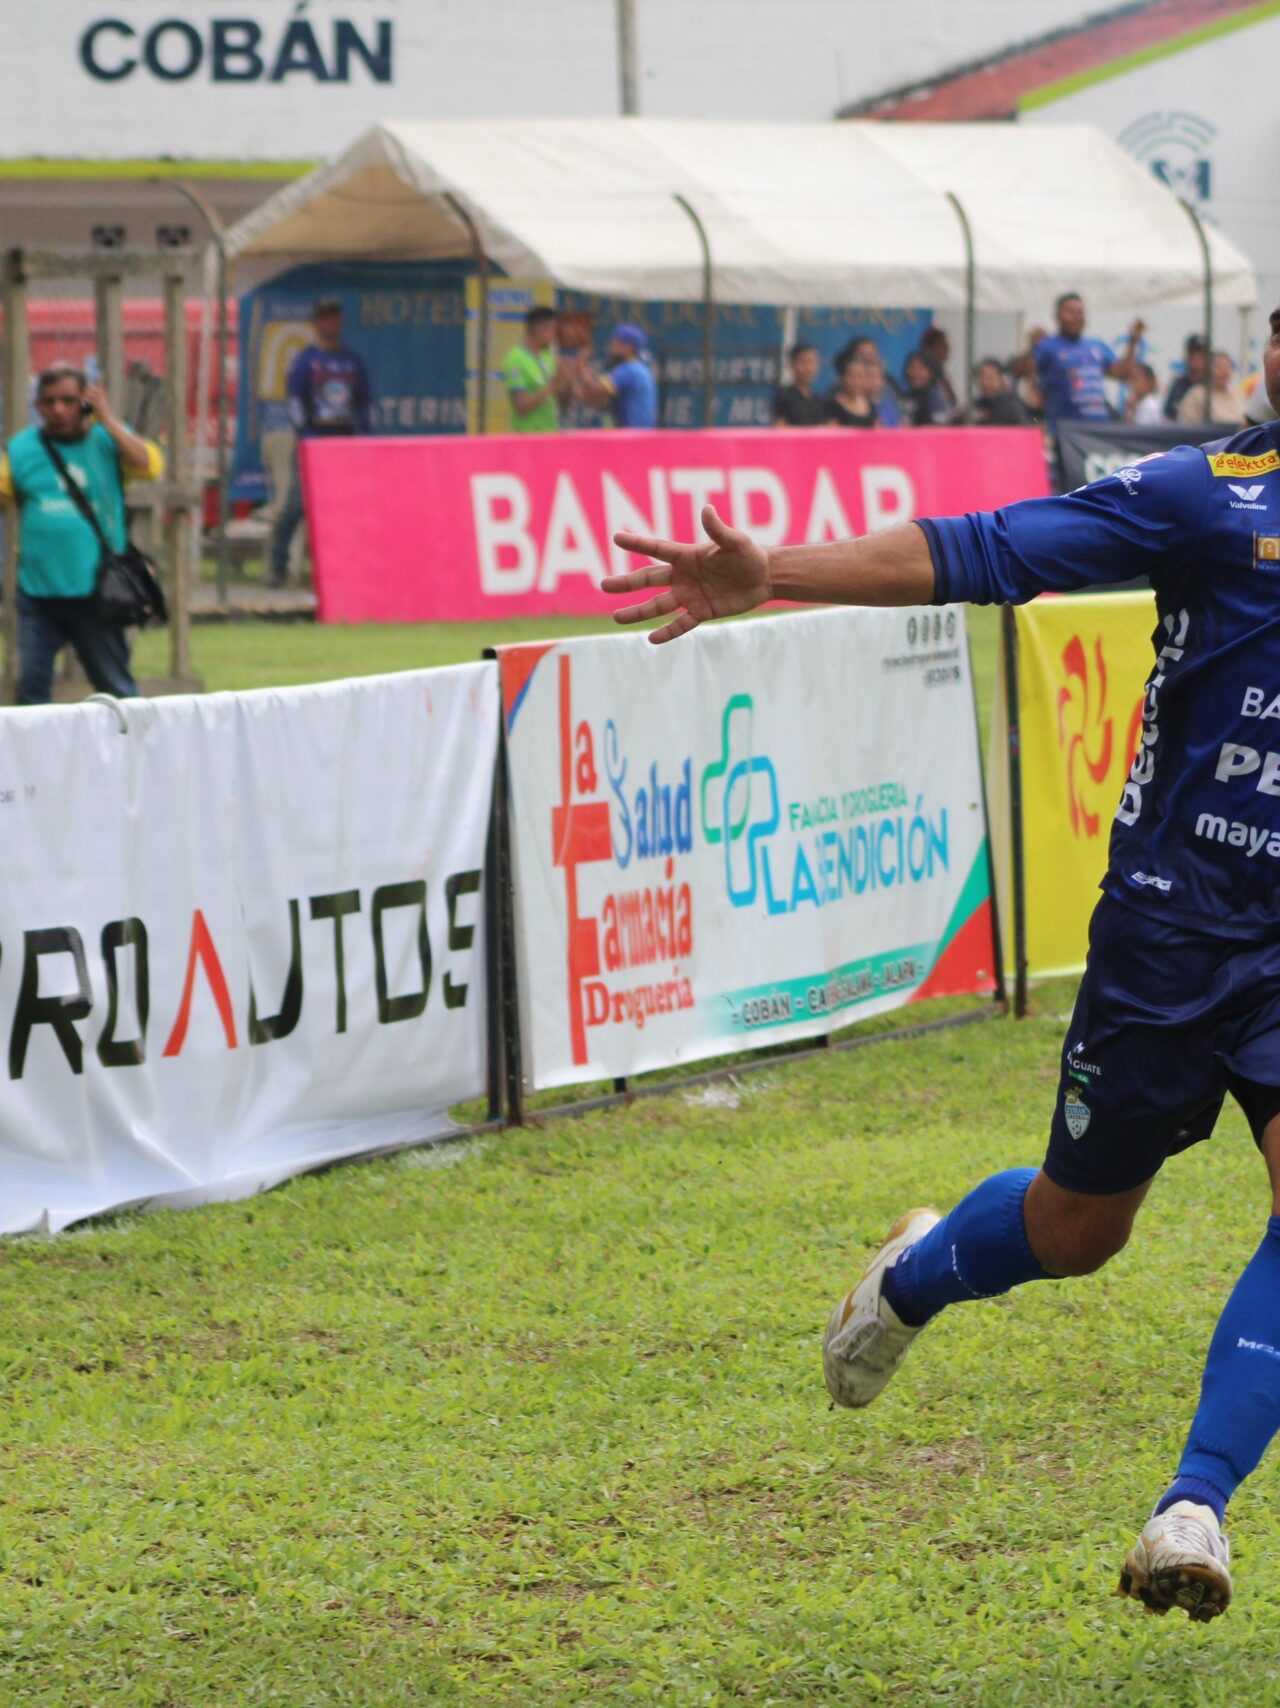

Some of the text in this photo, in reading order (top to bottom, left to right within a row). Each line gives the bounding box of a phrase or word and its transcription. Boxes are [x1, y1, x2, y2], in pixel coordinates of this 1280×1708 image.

[79, 2, 393, 83] COBÁN
[1226, 454, 1277, 471] elektra
[1228, 500, 1268, 512] Valvoline
[603, 718, 693, 870] Salud
[816, 793, 949, 906] ENDICIÓN
